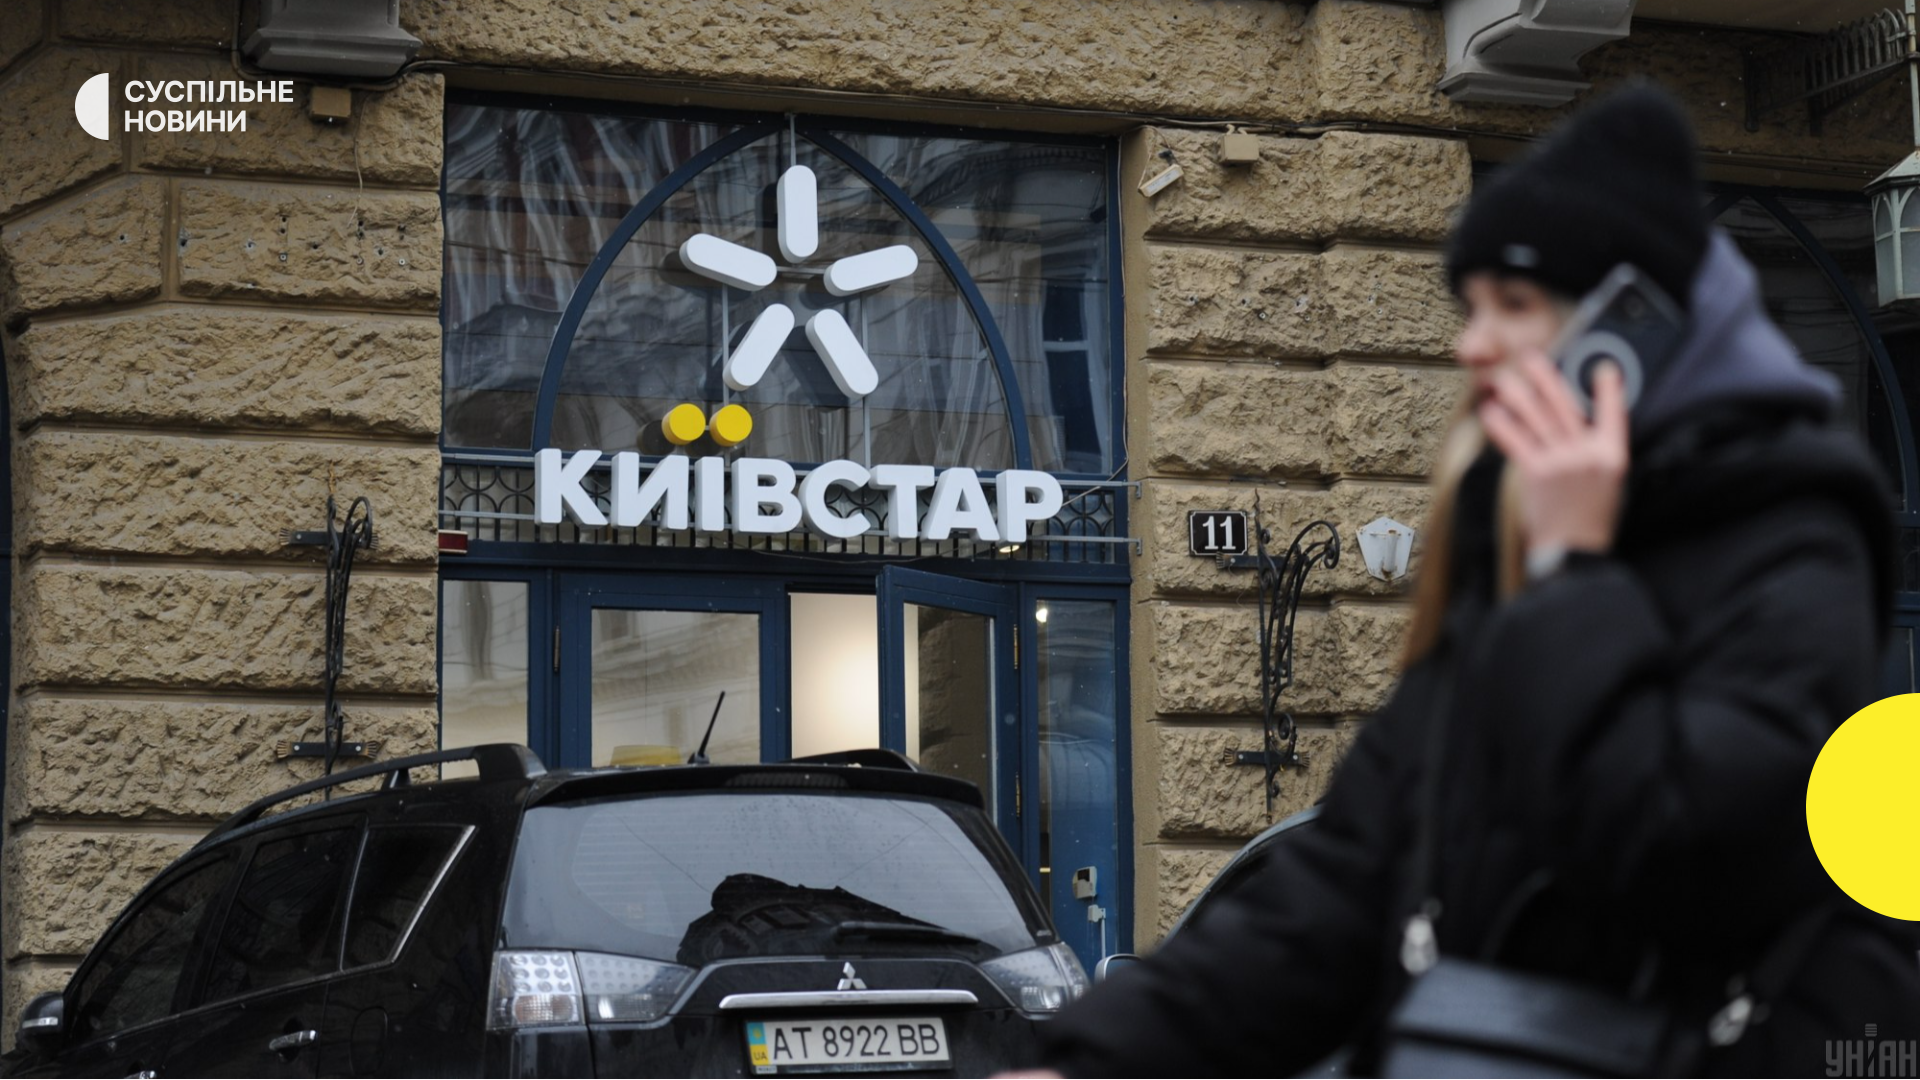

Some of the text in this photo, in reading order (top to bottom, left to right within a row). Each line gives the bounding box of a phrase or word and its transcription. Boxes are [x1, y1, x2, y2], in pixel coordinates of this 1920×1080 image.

[1202, 515, 1236, 550] 11
[753, 1051, 768, 1061] UA
[822, 1025, 892, 1059] 8922
[897, 1023, 940, 1056] BB
